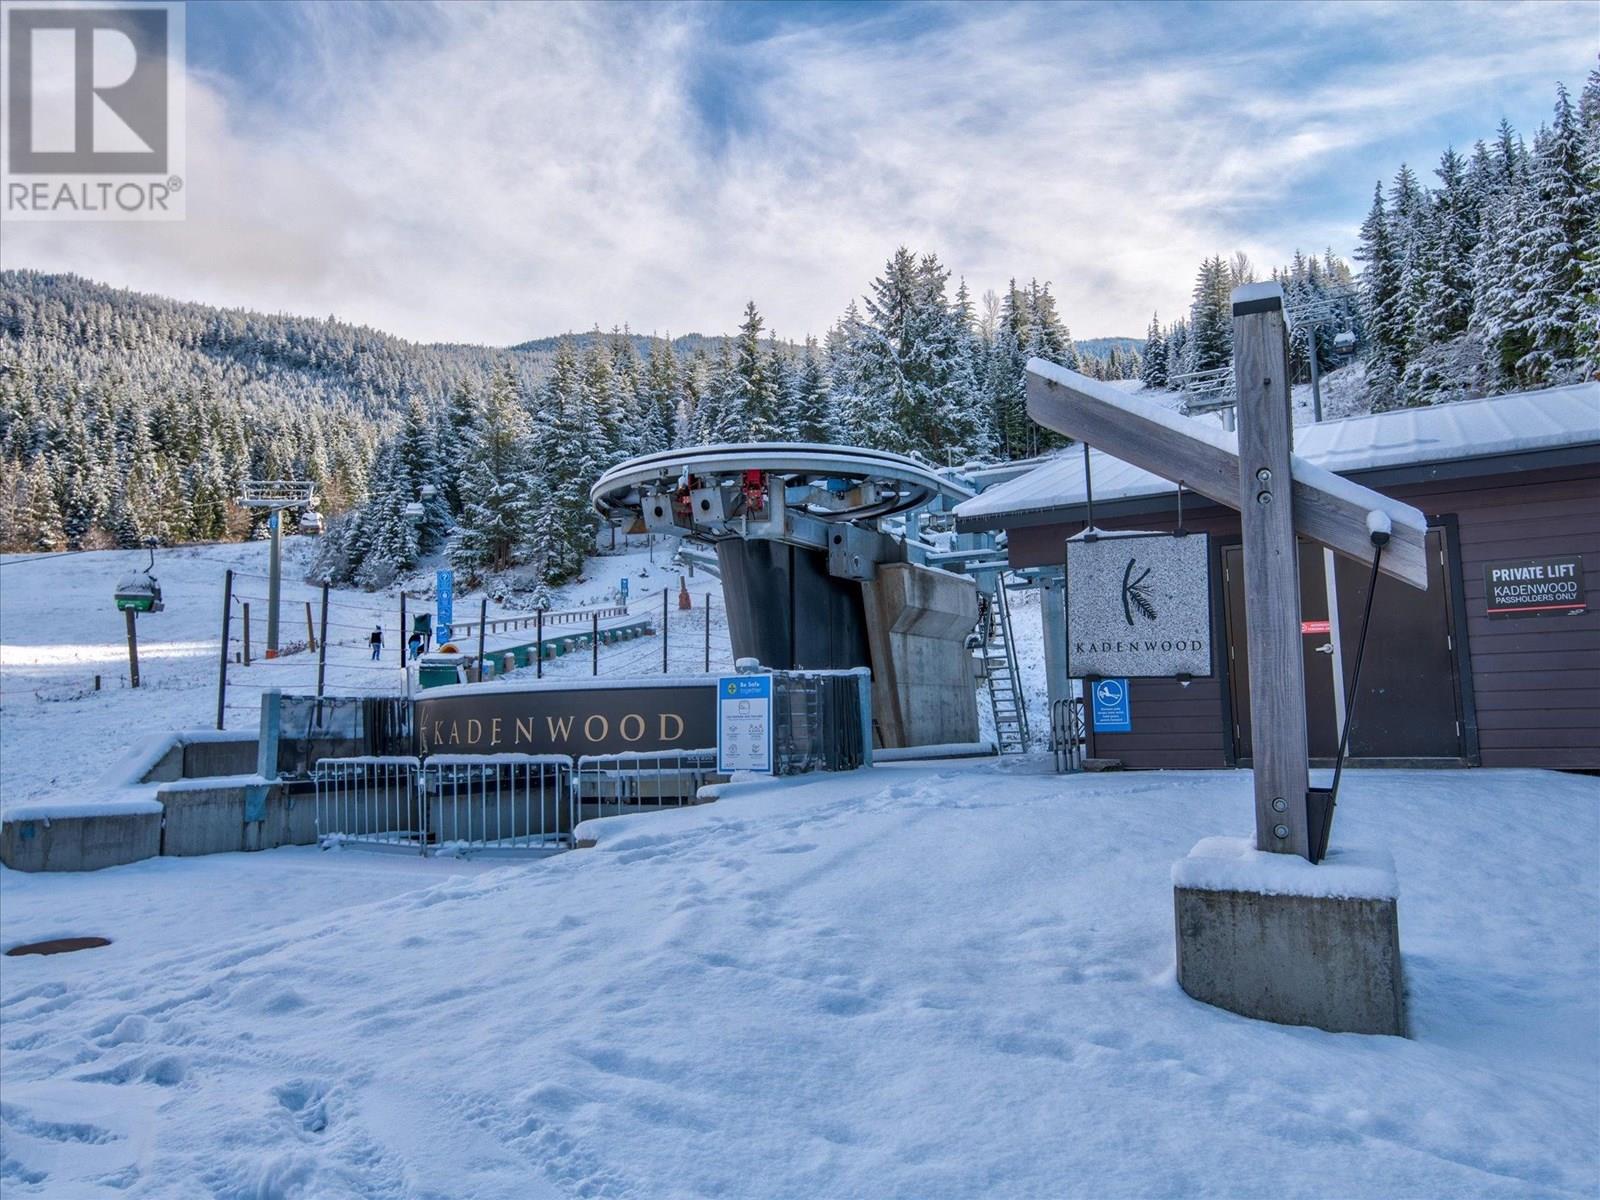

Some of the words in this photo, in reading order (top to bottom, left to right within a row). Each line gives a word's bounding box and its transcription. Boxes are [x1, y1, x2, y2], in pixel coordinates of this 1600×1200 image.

[1492, 566, 1544, 582] PRIVATE
[1547, 564, 1575, 578] LIFT
[1494, 581, 1577, 596] KADENWOOD
[1496, 594, 1554, 604] PASSHOLDERS
[1555, 592, 1577, 600] ONLY
[1076, 640, 1203, 654] KADENWOOD
[434, 713, 685, 746] KADENWOOD
